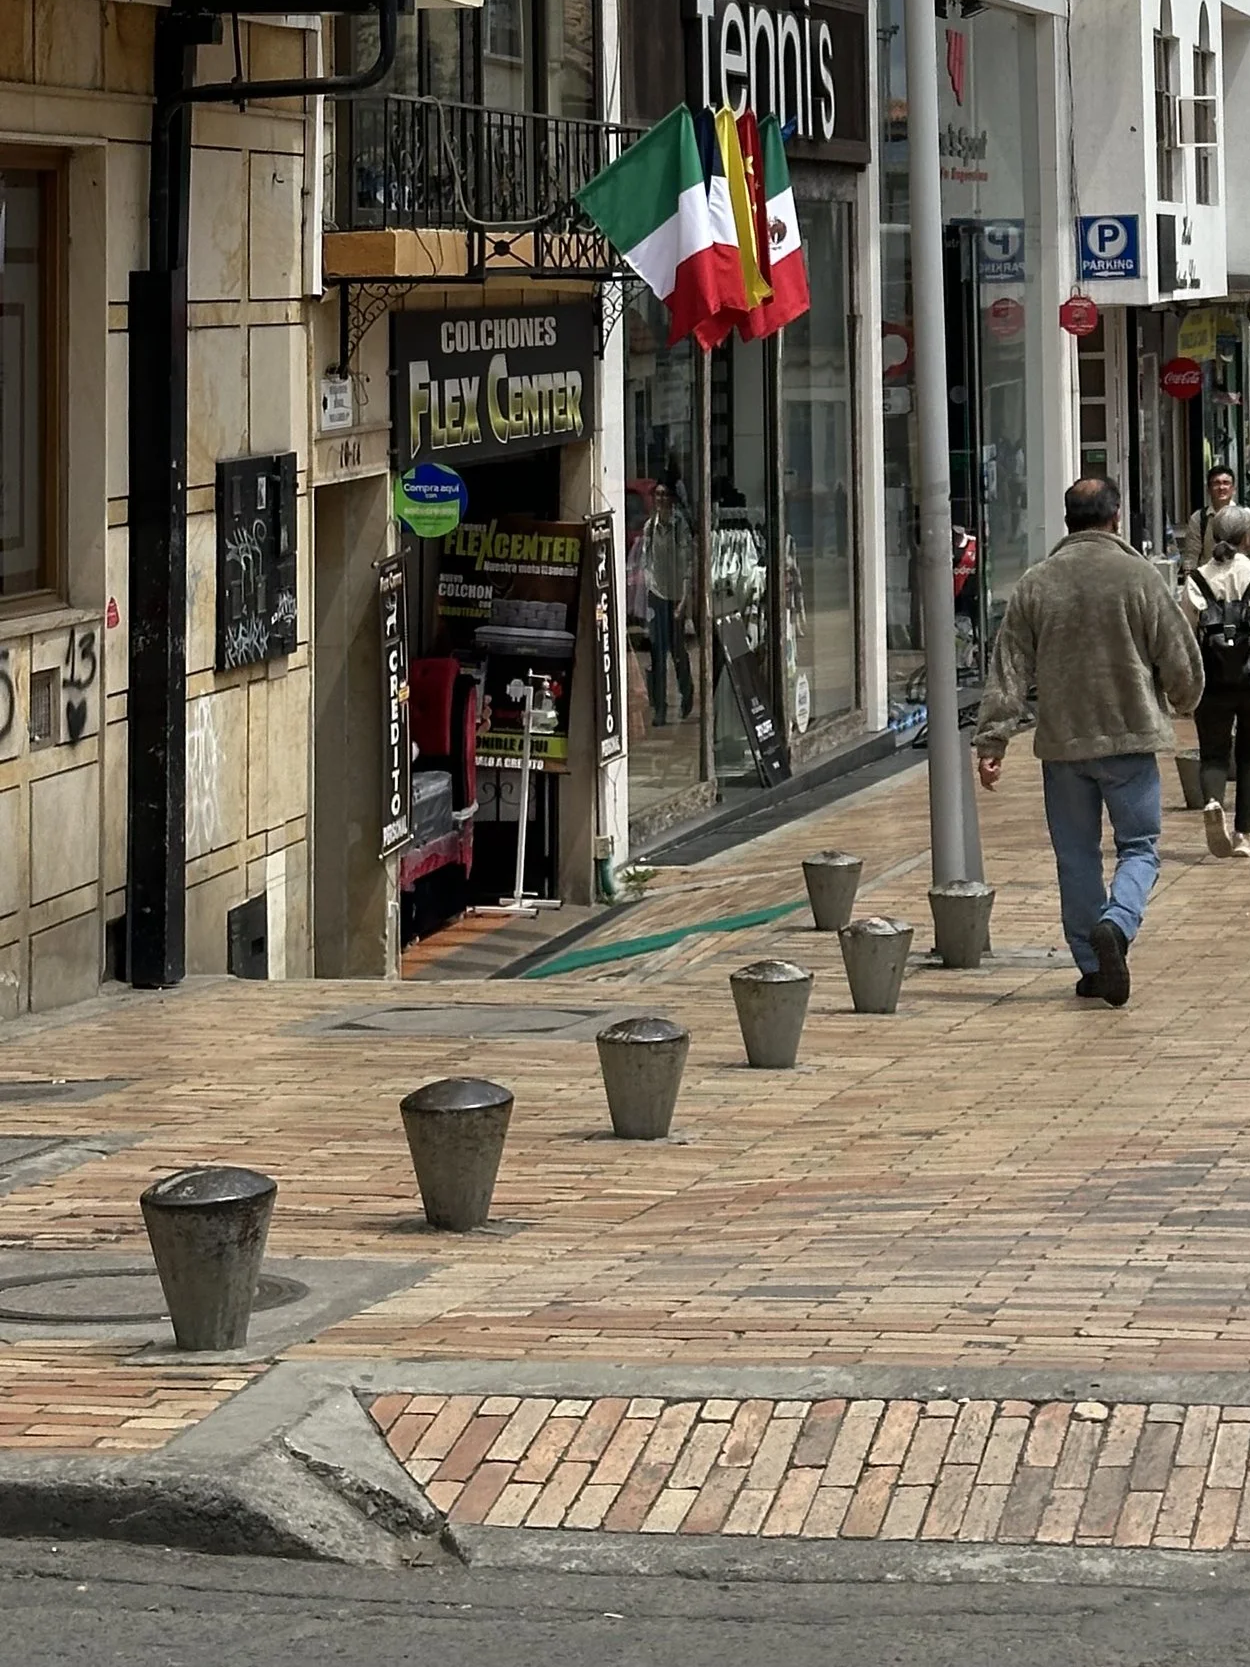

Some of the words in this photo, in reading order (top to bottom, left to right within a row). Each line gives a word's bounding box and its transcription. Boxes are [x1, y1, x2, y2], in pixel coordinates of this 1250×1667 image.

[1098, 224, 1119, 253] P
[1083, 259, 1134, 271] PARKING
[441, 316, 557, 354] COLCHONES
[438, 583, 493, 599] COLCHON
[388, 649, 401, 816] CREDITO
